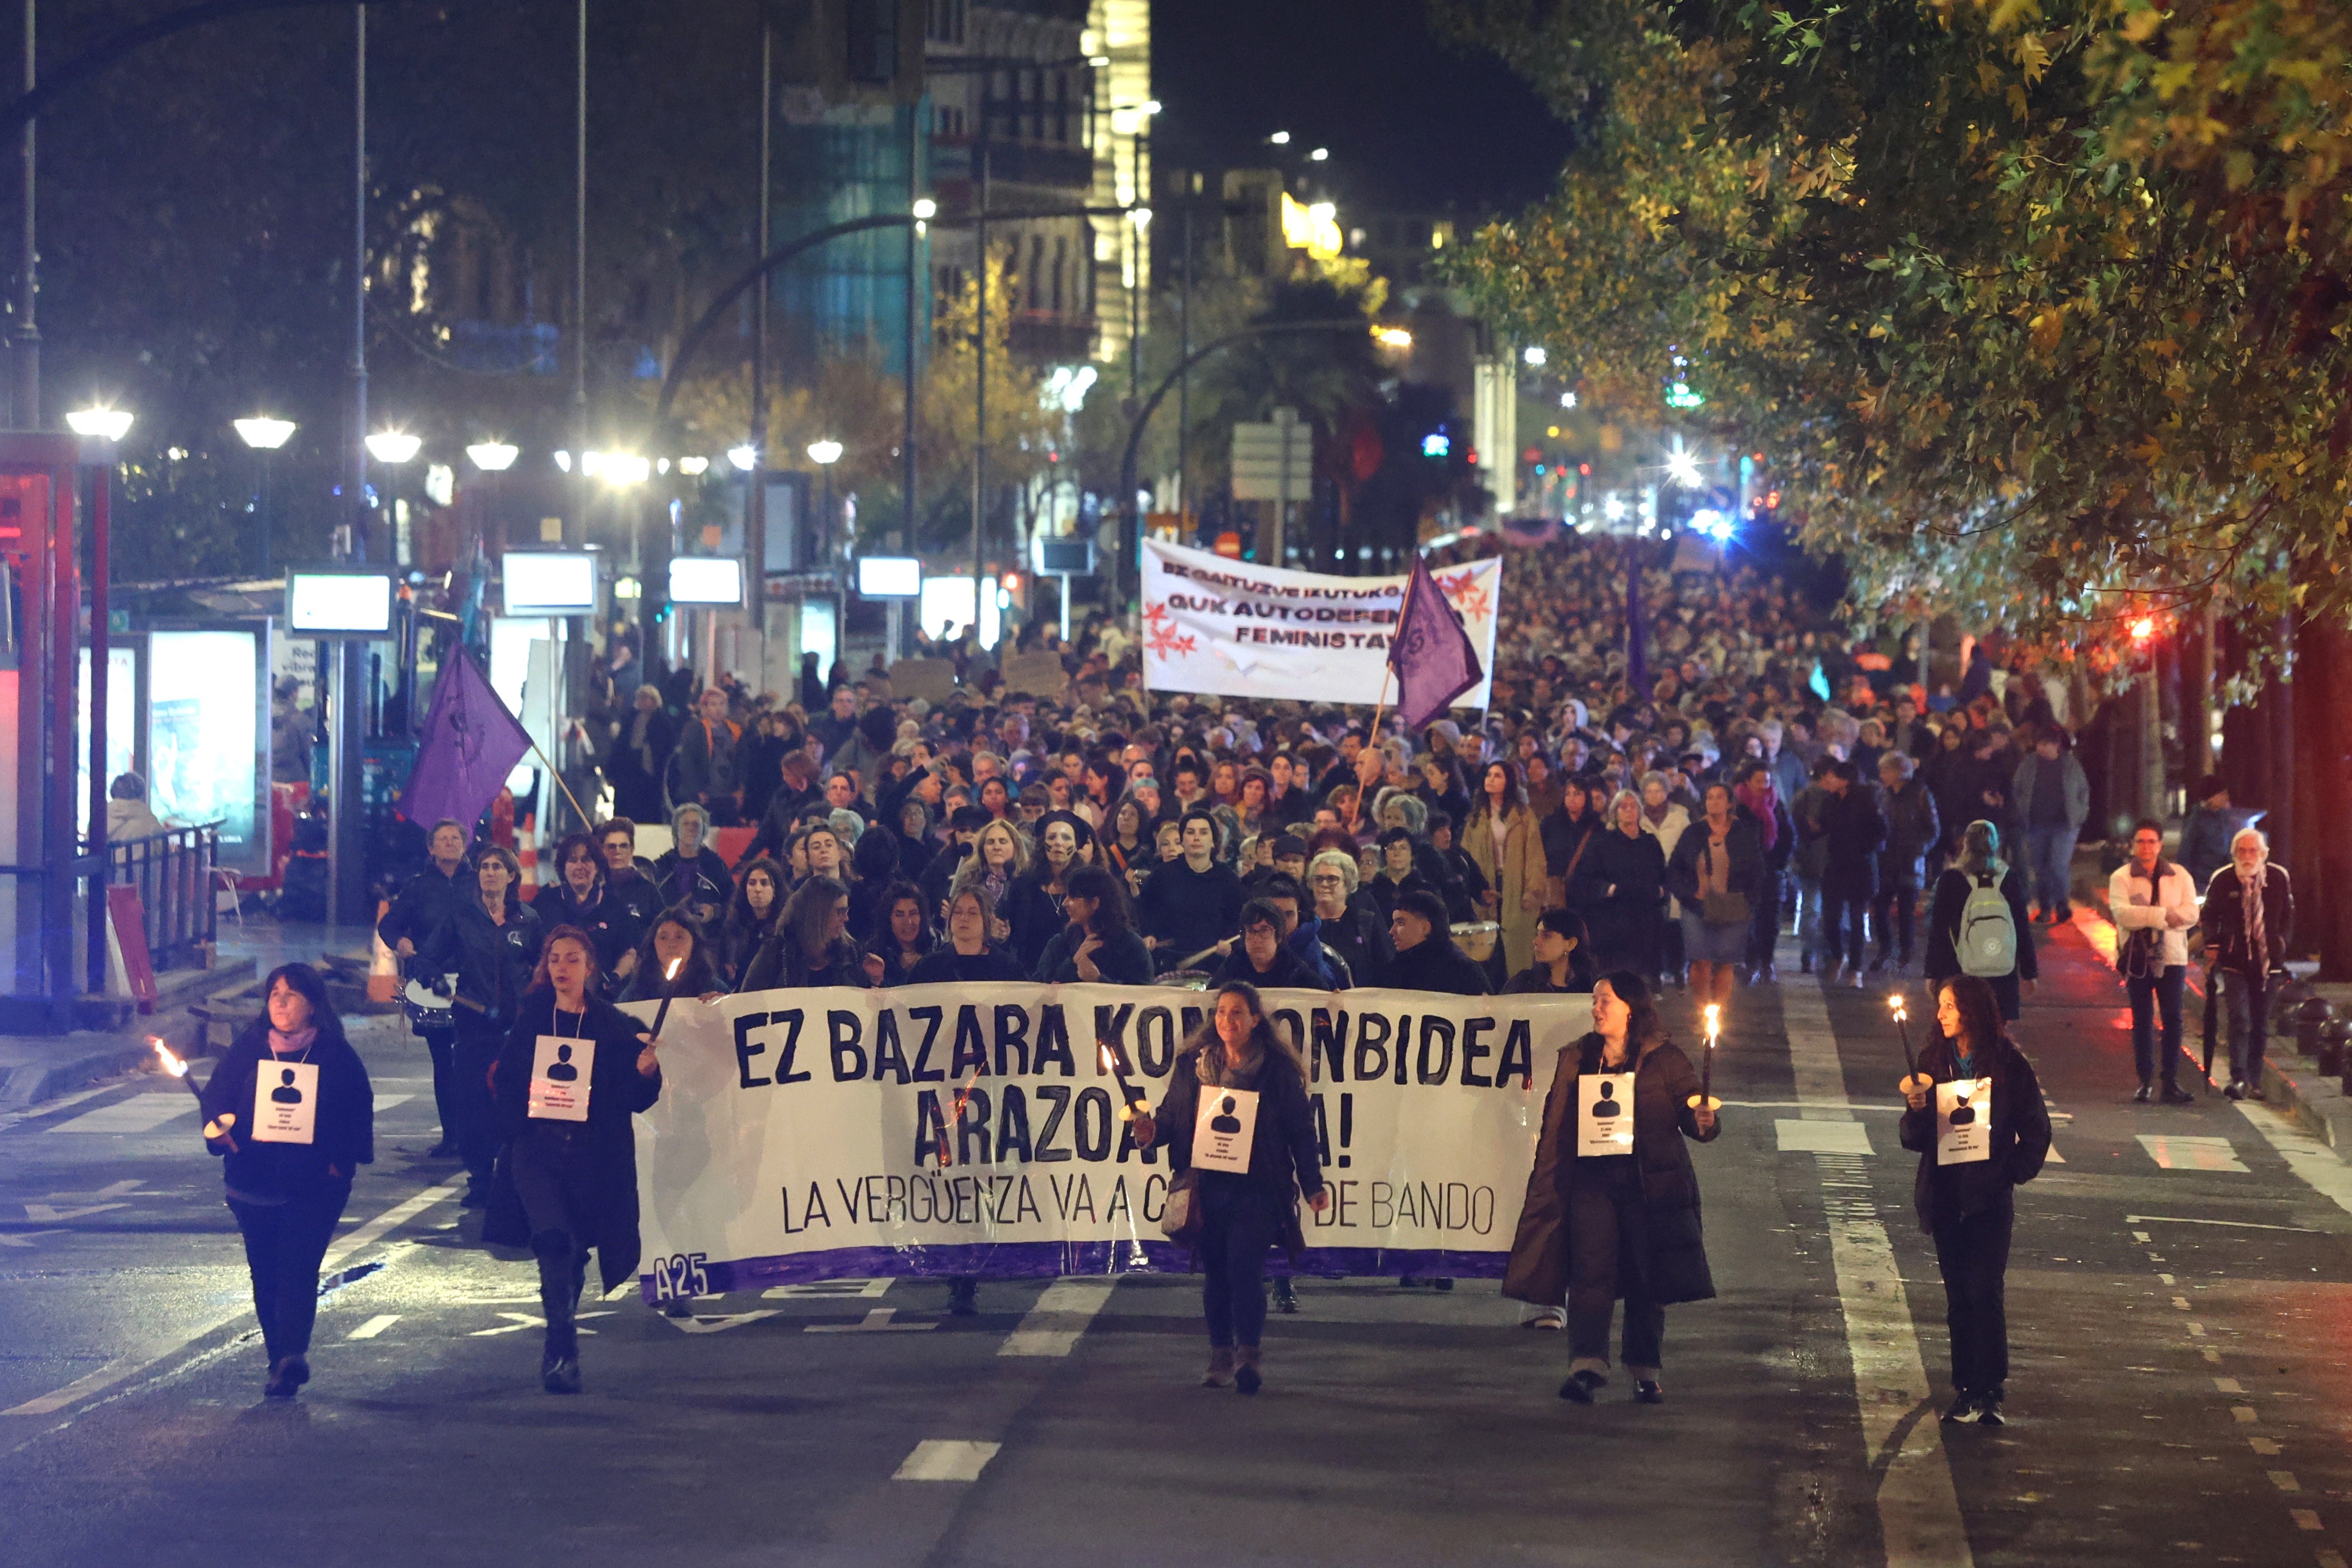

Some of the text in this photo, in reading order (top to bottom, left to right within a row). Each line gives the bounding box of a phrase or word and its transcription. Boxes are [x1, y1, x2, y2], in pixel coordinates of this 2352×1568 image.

[734, 1002, 1532, 1090] EZ BAZARA KOONBIDEA
[781, 1181, 831, 1234] LA
[837, 1172, 1041, 1224] VERGÜENZA
[1050, 1173, 1097, 1224] VA
[1107, 1174, 1131, 1223] A
[1314, 1180, 1359, 1227] DE
[1371, 1180, 1495, 1235] BANDO
[652, 1252, 709, 1300] A25
